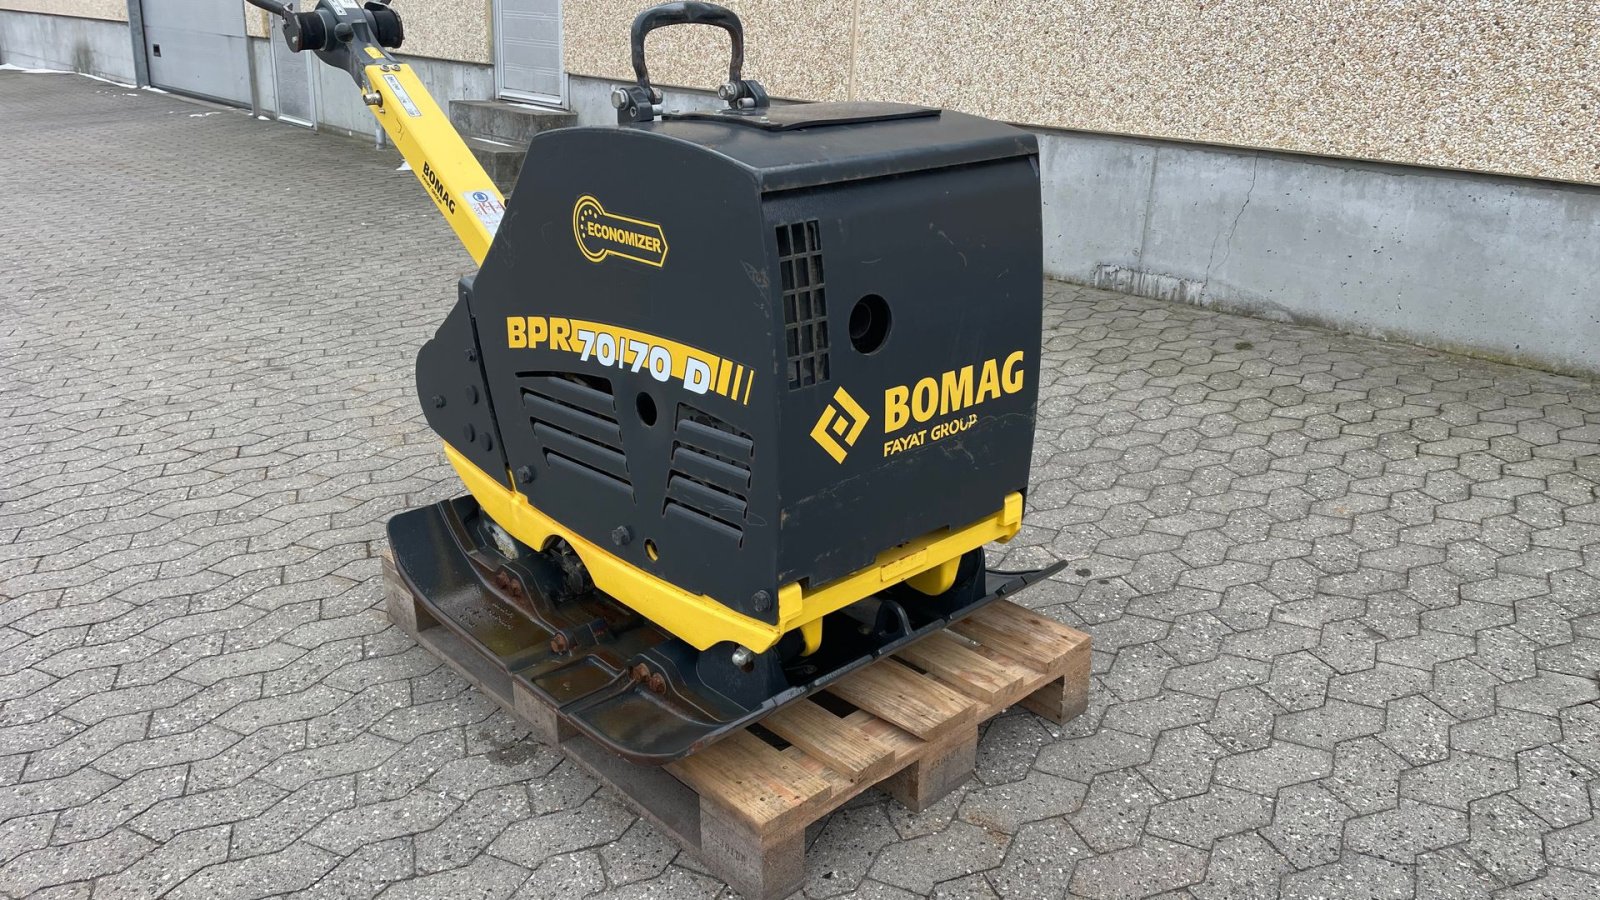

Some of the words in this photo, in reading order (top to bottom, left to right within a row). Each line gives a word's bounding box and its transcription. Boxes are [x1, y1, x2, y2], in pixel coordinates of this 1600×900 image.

[423, 161, 456, 215] BOMAG
[587, 221, 662, 254] ECONOMIZER
[506, 316, 571, 352] BPR
[682, 356, 712, 395] D
[884, 350, 1025, 434] BOMAG
[883, 429, 927, 458] FAYAT
[930, 413, 978, 441] GROUP
